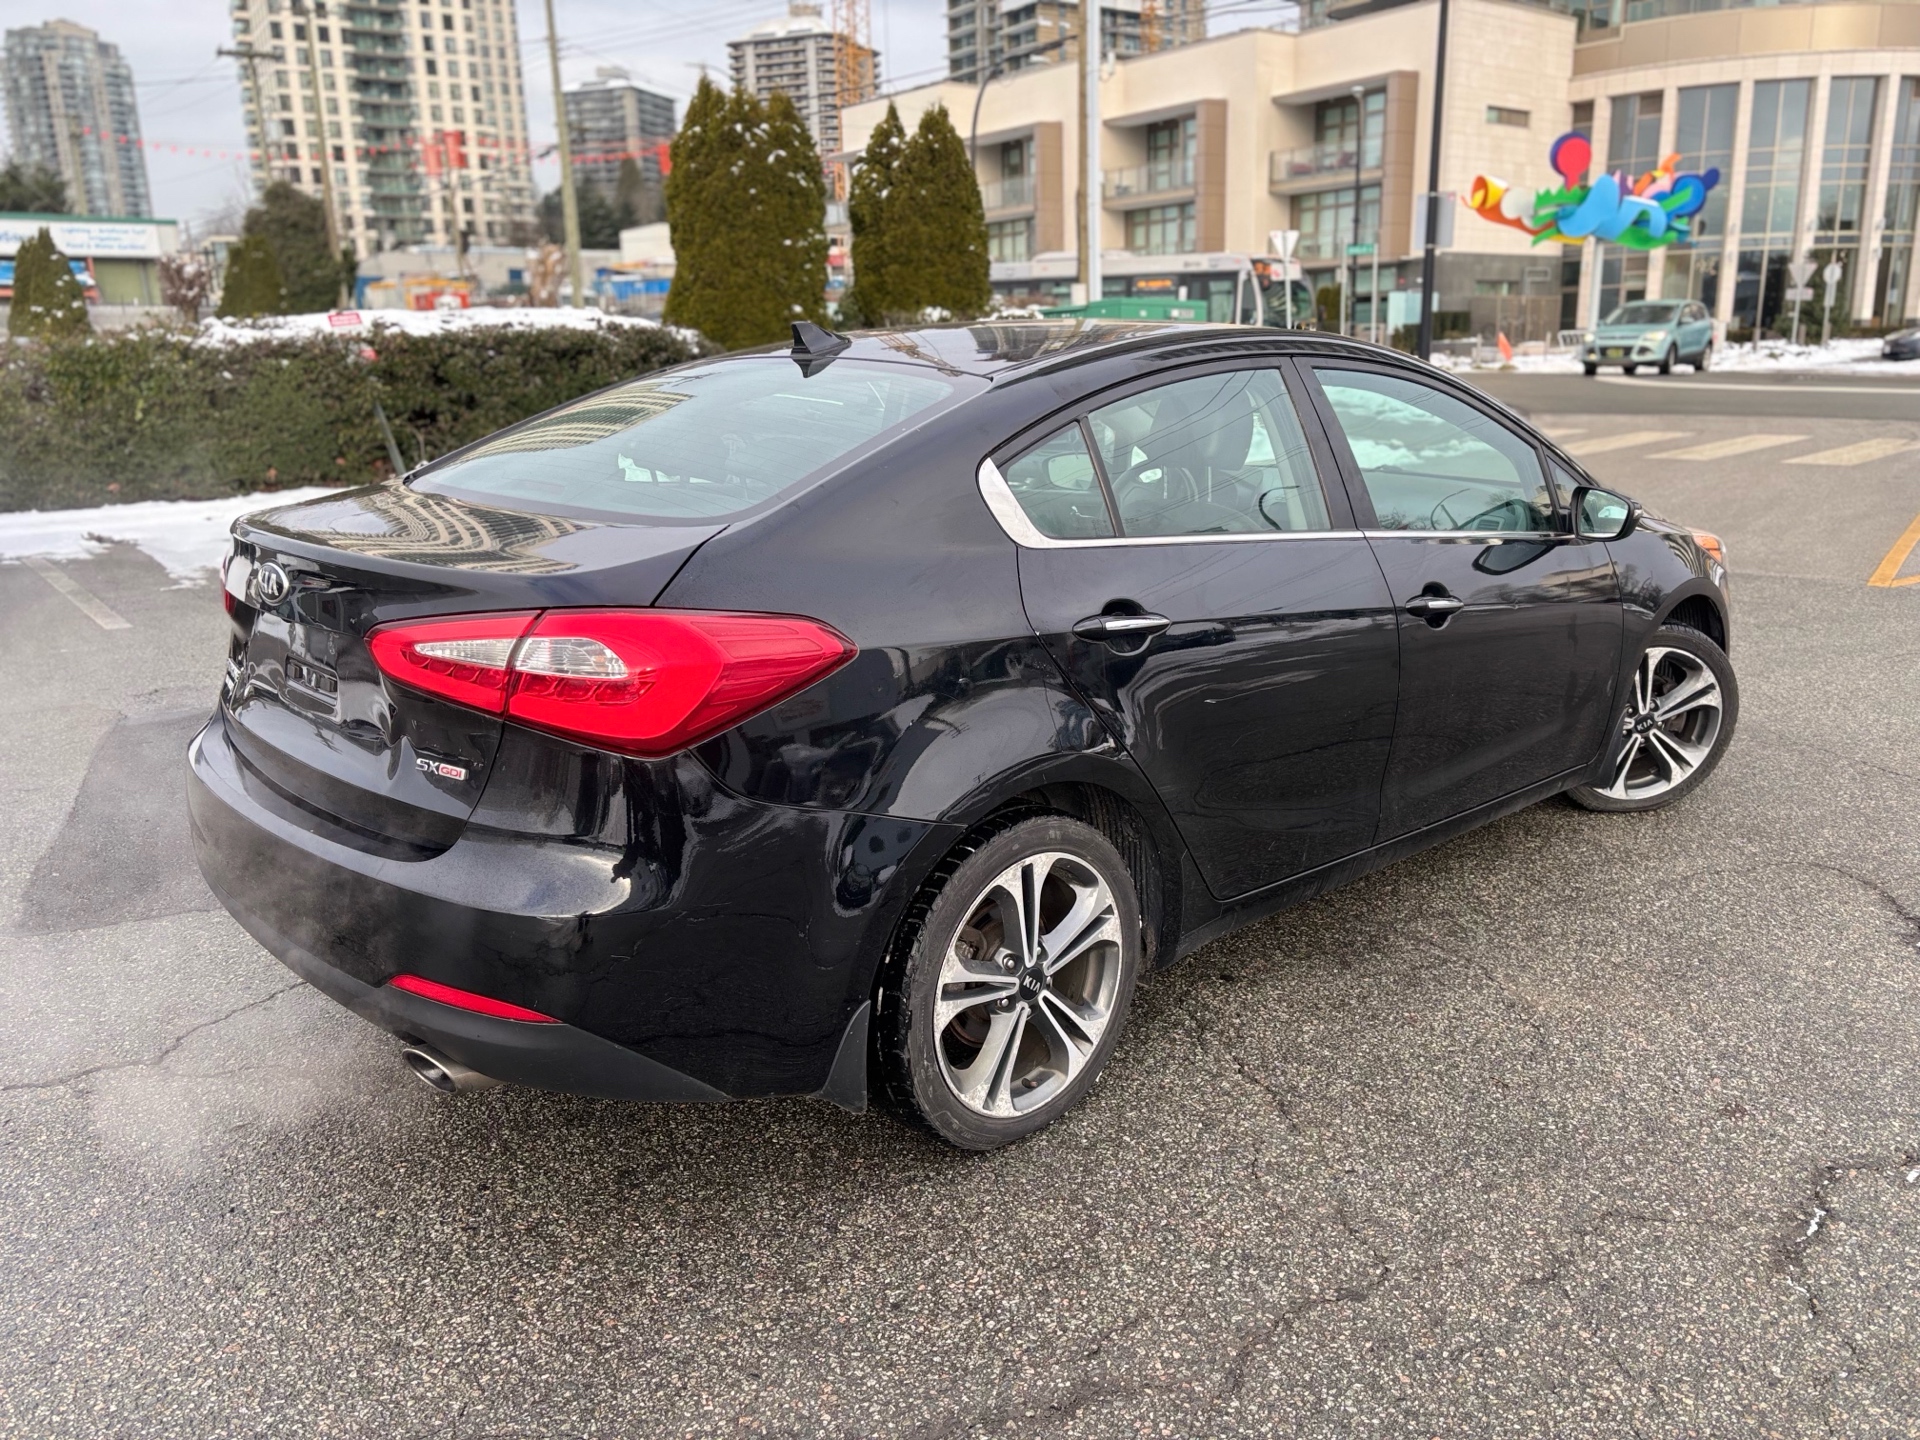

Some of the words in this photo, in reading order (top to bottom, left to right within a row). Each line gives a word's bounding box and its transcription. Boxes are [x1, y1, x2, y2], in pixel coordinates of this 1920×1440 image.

[260, 570, 279, 596] KIA
[1637, 719, 1653, 731] KIA
[415, 758, 440, 775] SX
[440, 766, 463, 779] GDI
[1022, 975, 1041, 993] KIA
